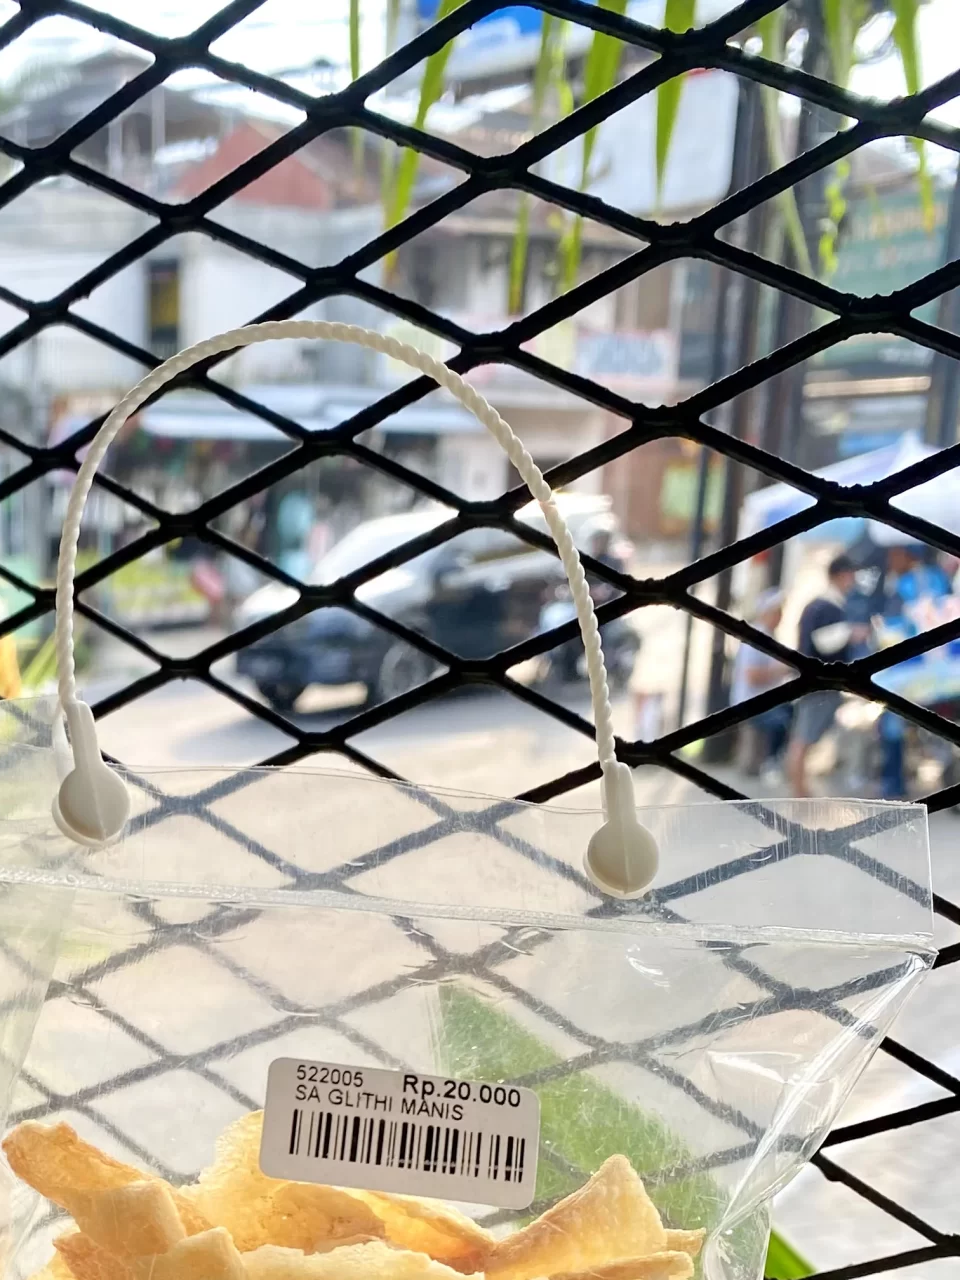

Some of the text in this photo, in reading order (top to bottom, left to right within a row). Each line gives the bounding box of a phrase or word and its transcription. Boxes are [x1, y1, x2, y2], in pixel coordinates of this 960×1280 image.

[295, 1085, 464, 1121] SA GLITHI MANIS
[297, 1065, 520, 1107] 522005 Rp.20.000
